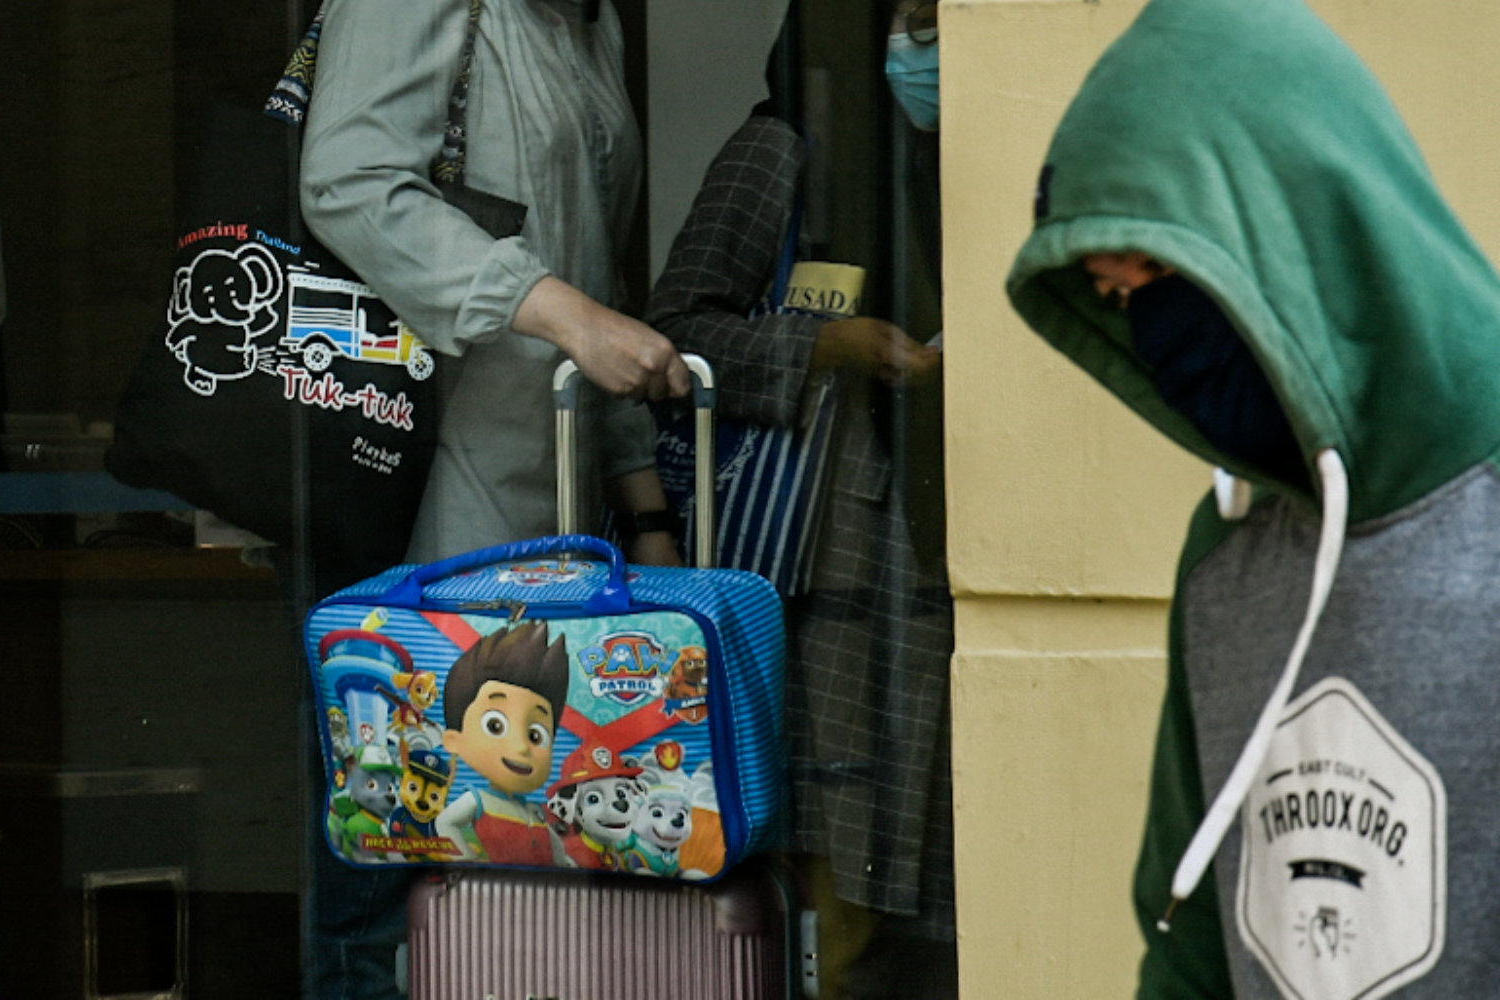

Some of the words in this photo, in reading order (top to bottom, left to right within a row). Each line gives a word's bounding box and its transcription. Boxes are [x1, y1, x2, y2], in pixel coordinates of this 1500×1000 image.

[177, 220, 249, 251] Amazing
[255, 229, 301, 255] Thailand
[276, 364, 414, 431] Tuk-tuk
[577, 643, 680, 678] PAW
[599, 679, 657, 692] PATROL
[1260, 789, 1354, 844] THROOX
